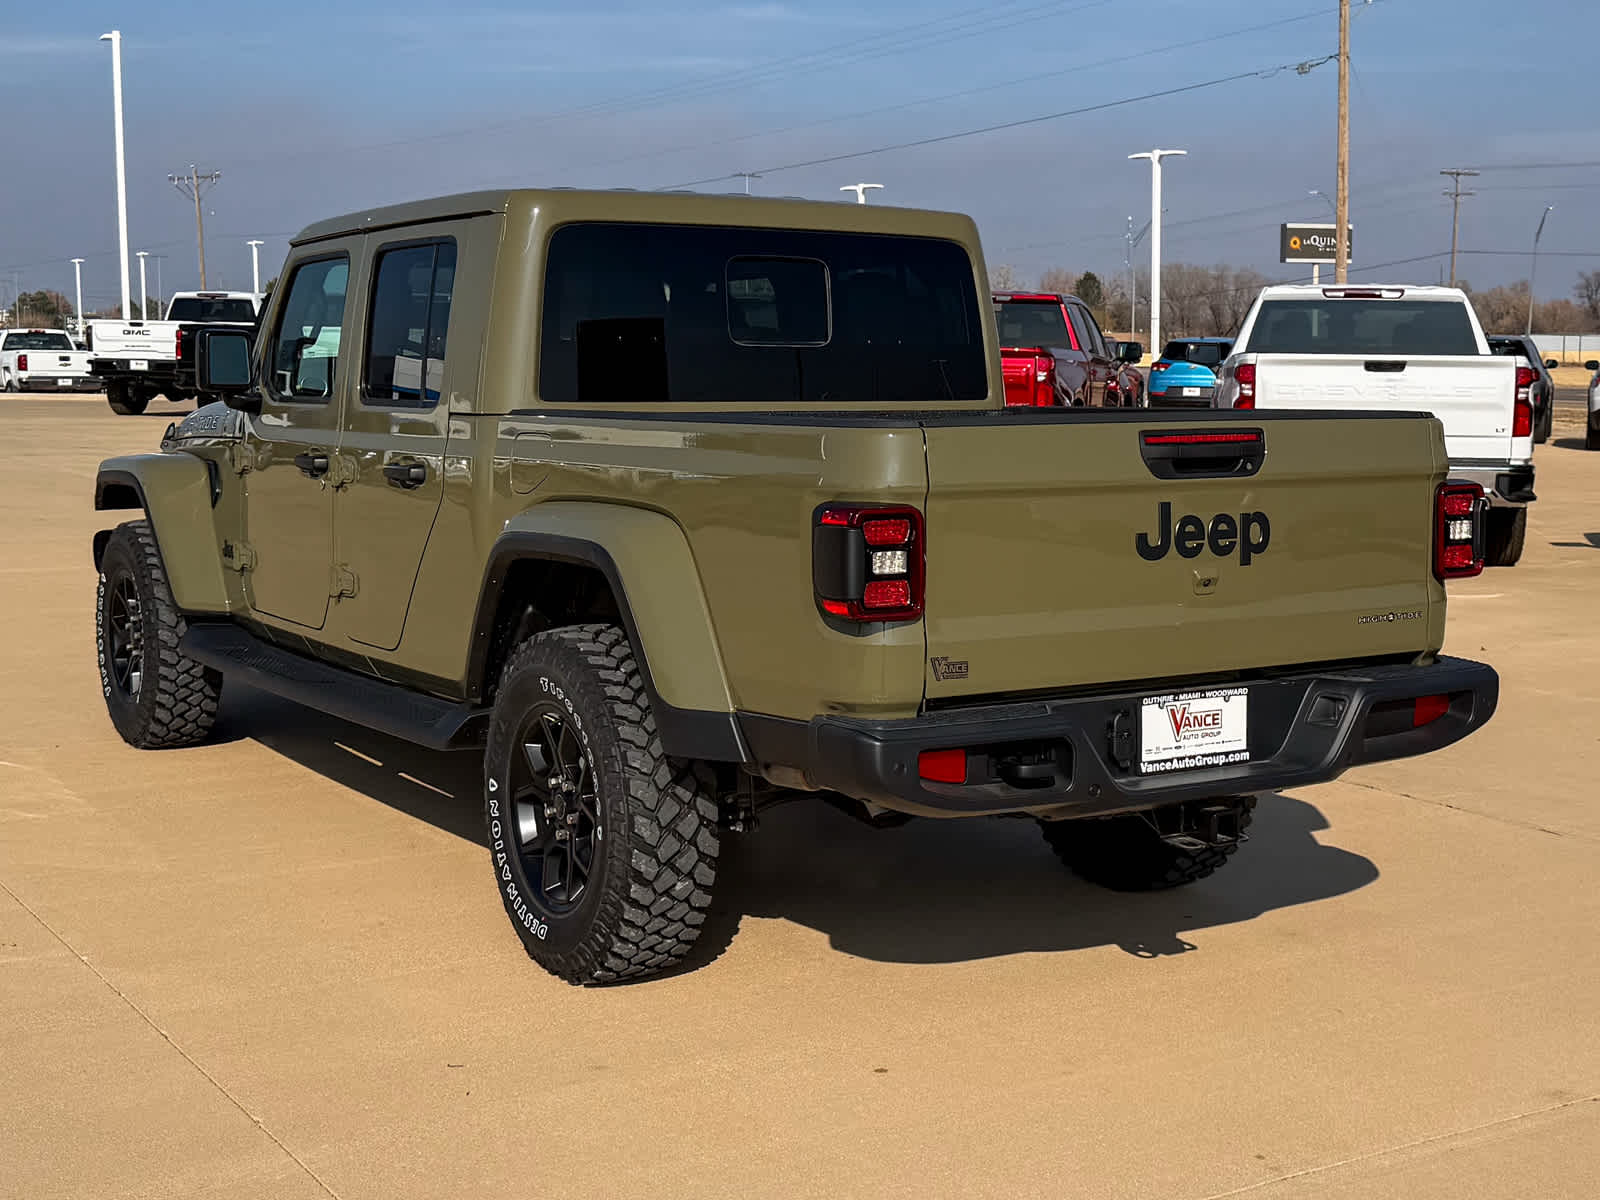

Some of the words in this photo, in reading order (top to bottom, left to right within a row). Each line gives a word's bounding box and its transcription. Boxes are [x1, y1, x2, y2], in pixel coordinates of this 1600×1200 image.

[1135, 501, 1271, 566] Jeep
[931, 656, 968, 681] VANCE
[1179, 691, 1201, 700] MIAMI
[1205, 688, 1249, 698] WOODWARD
[1167, 704, 1221, 741] VANCE
[1140, 751, 1250, 773] VanceAutoGroup.com
[489, 800, 549, 941] DESTINATION
